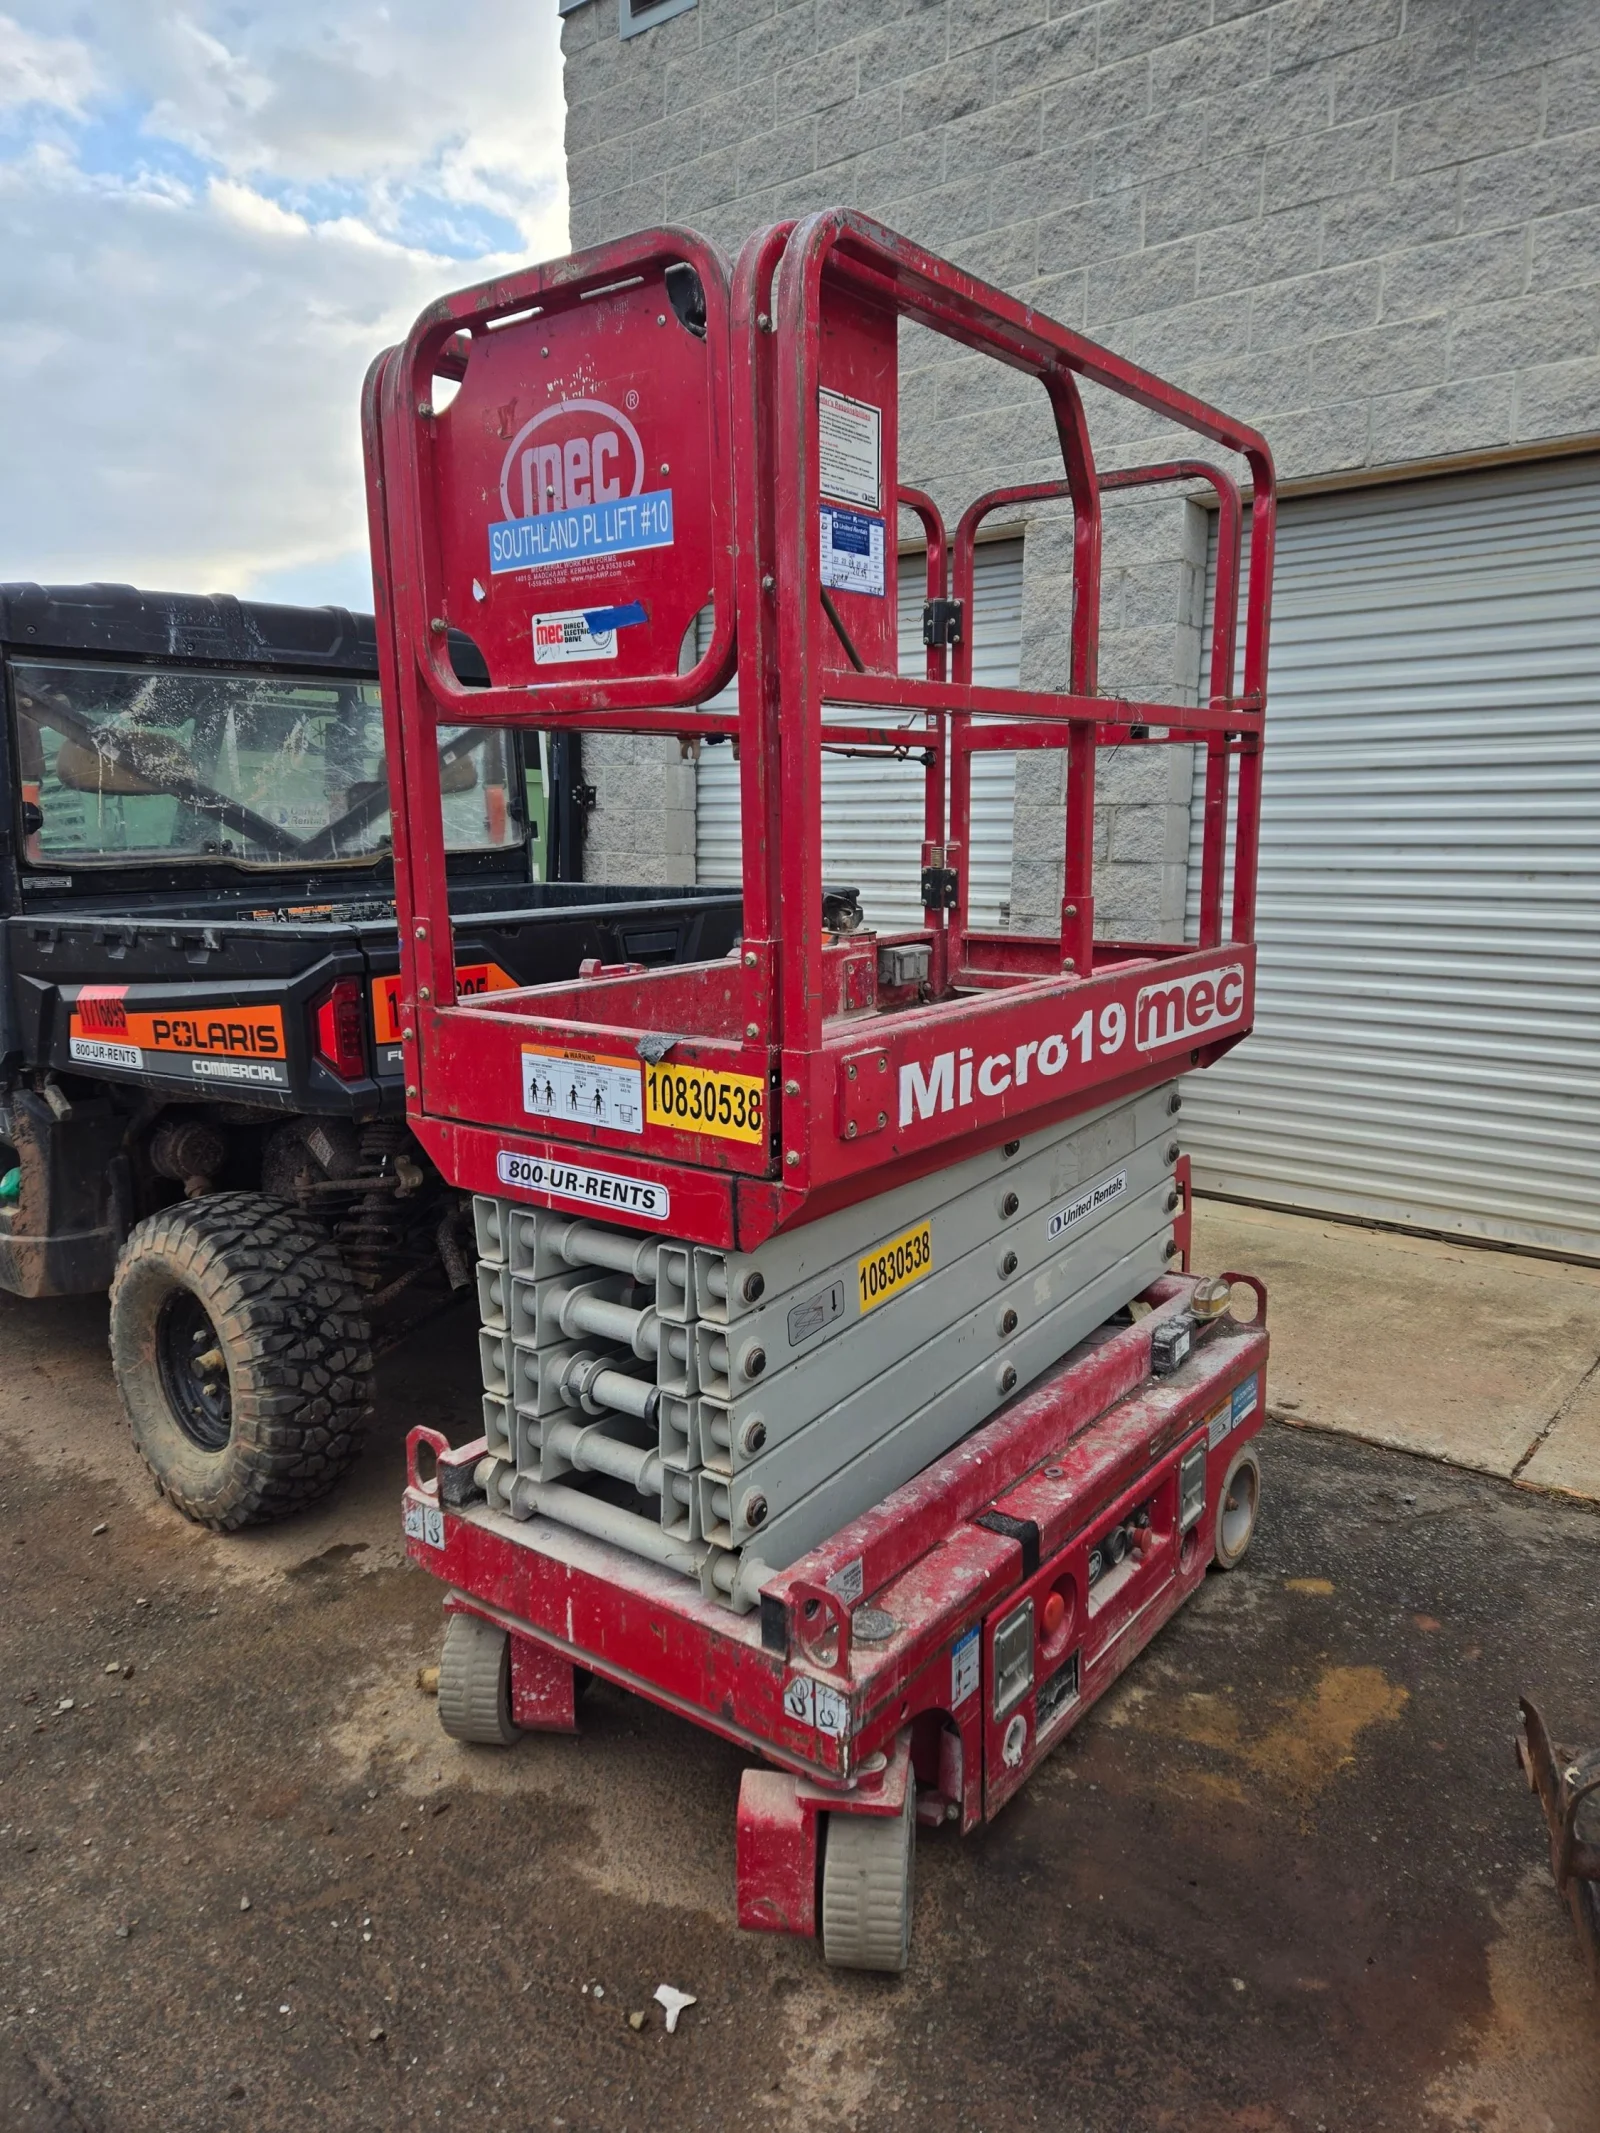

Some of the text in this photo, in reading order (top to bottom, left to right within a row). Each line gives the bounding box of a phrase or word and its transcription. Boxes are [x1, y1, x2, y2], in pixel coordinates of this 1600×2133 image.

[521, 431, 620, 517] mec
[493, 500, 668, 561] SOUTHLAND PL LIFT #10
[839, 523, 853, 531] United
[853, 525, 868, 535] Rentals
[543, 562, 563, 571] AERIAL
[564, 559, 581, 568] WORK
[582, 554, 617, 566] PLATFORMS
[597, 563, 605, 571] CA
[536, 624, 563, 645] mec
[564, 621, 584, 629] DIRECT
[564, 628, 590, 637] ELECTRIC
[1139, 970, 1243, 1046] mec
[152, 1020, 279, 1053] POLARIS
[75, 1043, 136, 1064] 800-UR-RENTS
[570, 1050, 596, 1062] WARNING
[192, 1059, 283, 1082] COMMERCIAL
[648, 1074, 761, 1131] 10830538
[508, 1160, 656, 1210] 800-UR-RENTS
[1063, 1178, 1122, 1225] United Rentals
[860, 1231, 930, 1301] 10830538
